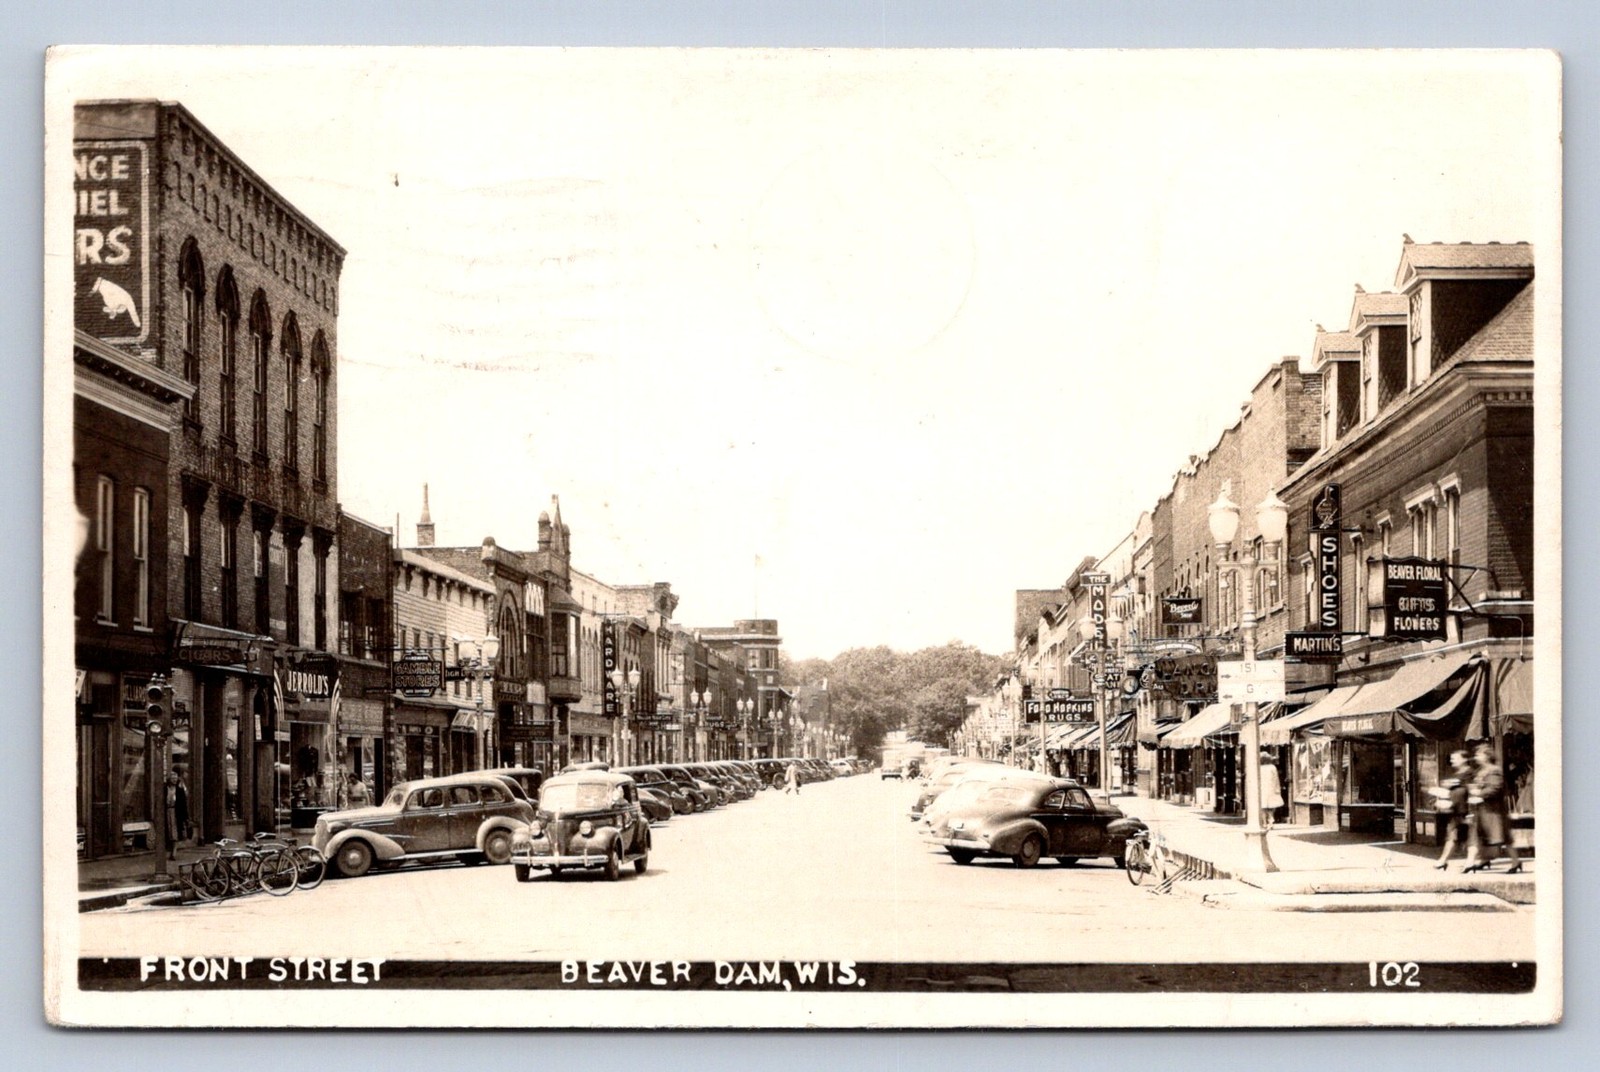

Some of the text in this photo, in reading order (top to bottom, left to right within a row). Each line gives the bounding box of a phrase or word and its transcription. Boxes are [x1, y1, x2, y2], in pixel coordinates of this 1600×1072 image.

[1388, 564, 1443, 581] BEAVER FLORAL
[1089, 576, 1108, 584] THE
[1322, 537, 1337, 627] SHOES
[1399, 597, 1435, 612] GIFTS
[1394, 617, 1440, 631] FLOWERS
[1294, 634, 1341, 652] MARTIN'S
[179, 649, 231, 661] CIGARS
[394, 662, 440, 675] GAMBLE
[604, 625, 614, 712] HARDWARE
[287, 670, 329, 696] JERROLD'S
[394, 675, 440, 687] STORES
[1247, 684, 1254, 693] G
[1028, 702, 1093, 714] FOD HOPKINS
